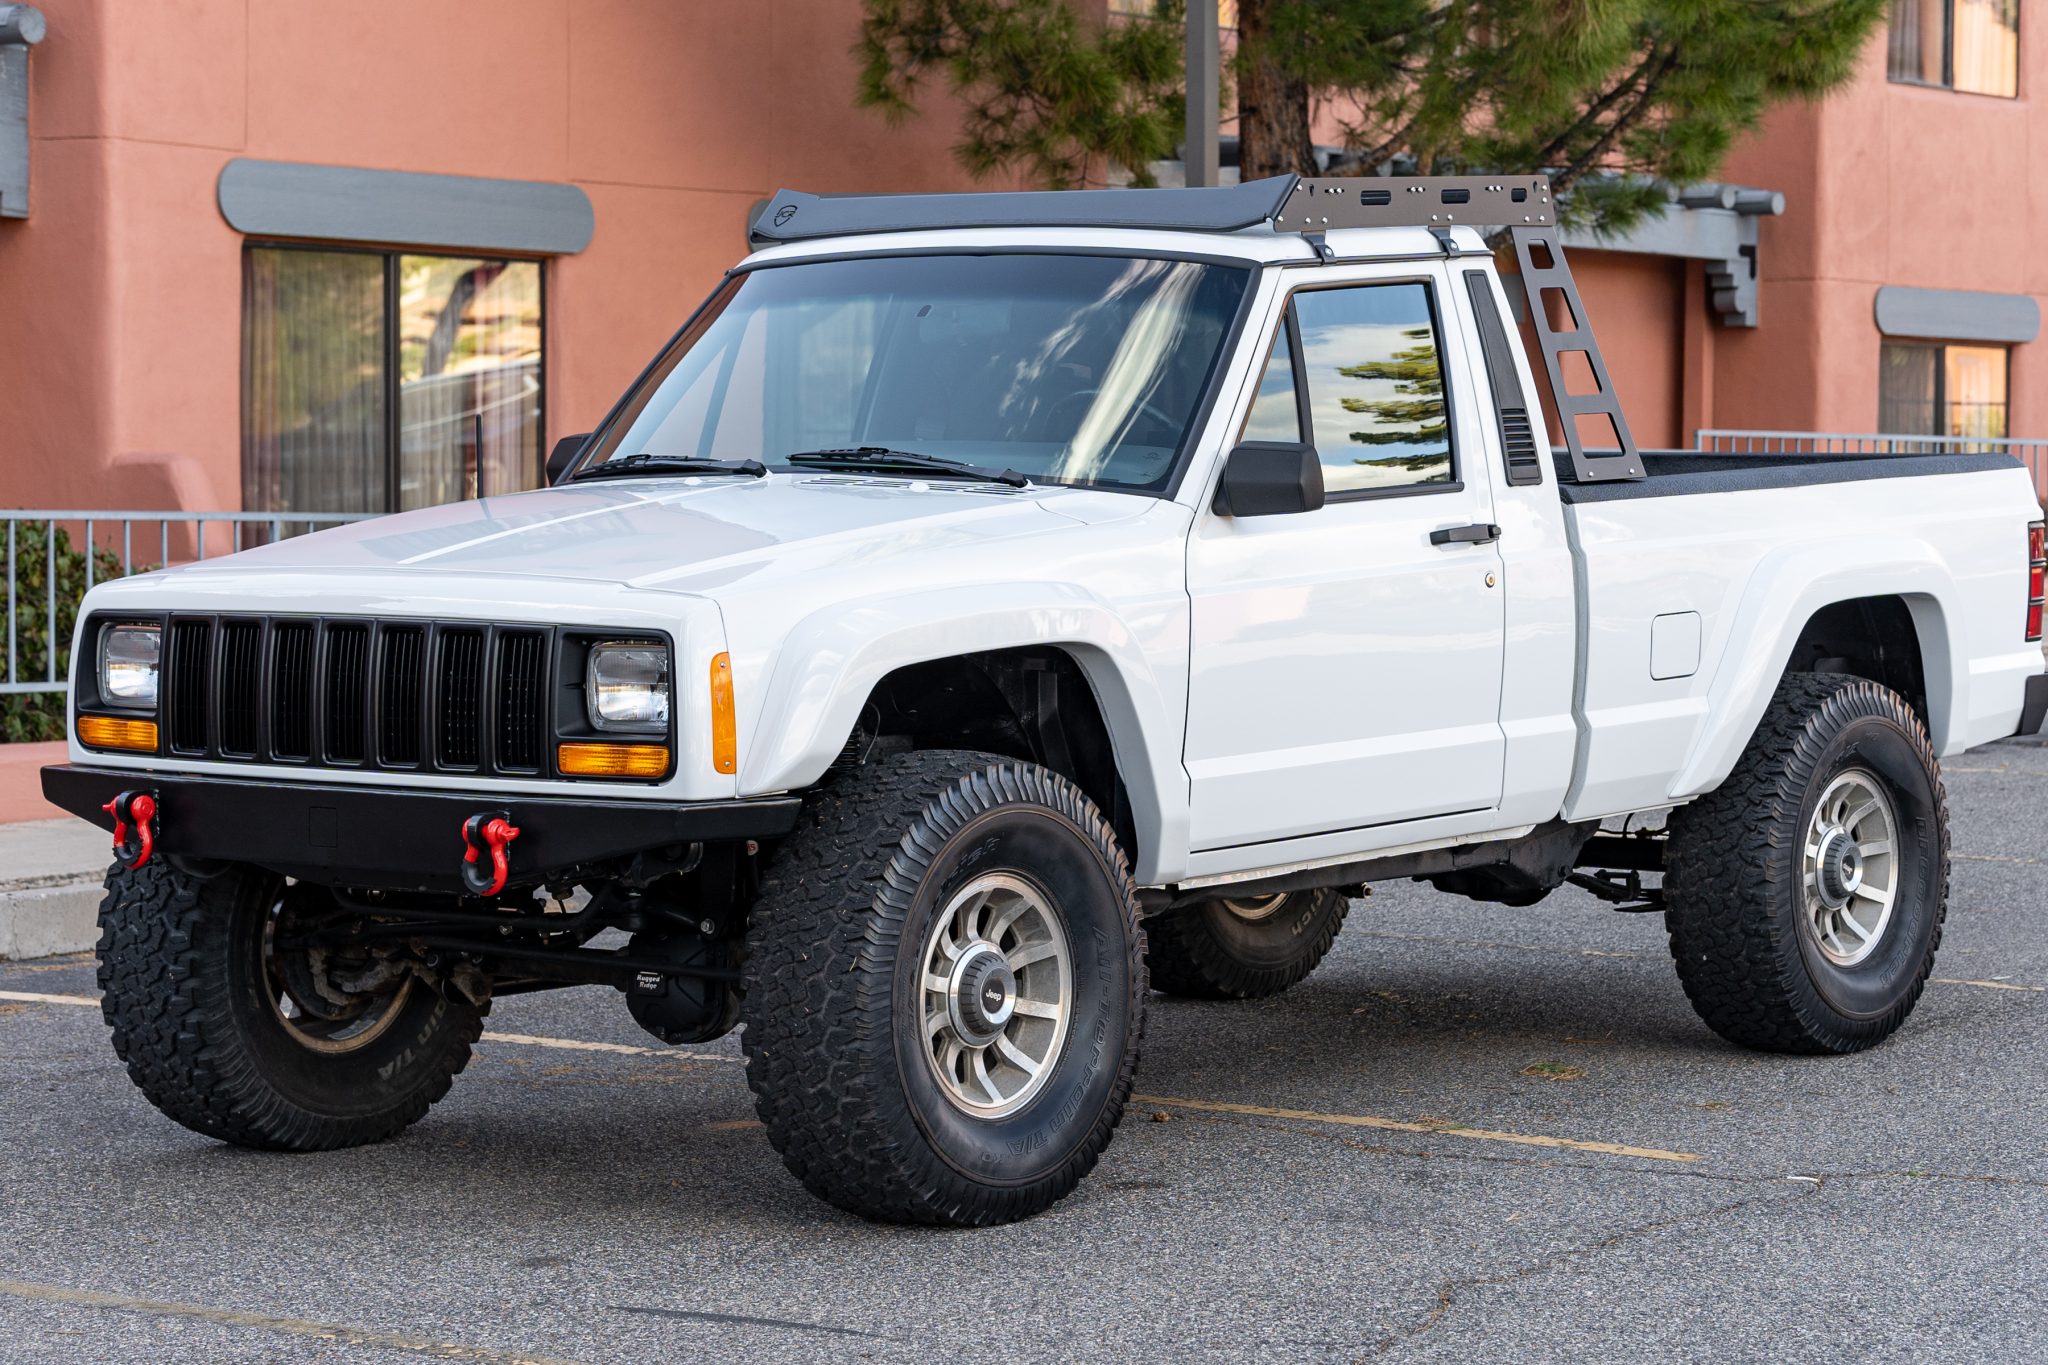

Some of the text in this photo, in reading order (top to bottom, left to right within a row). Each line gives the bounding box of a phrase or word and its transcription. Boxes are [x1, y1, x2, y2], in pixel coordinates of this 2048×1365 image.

[637, 974, 660, 982] Rugged
[640, 981, 657, 990] Ridge
[986, 989, 1001, 1001] Jeep
[1006, 1128, 1050, 1156] T/A
